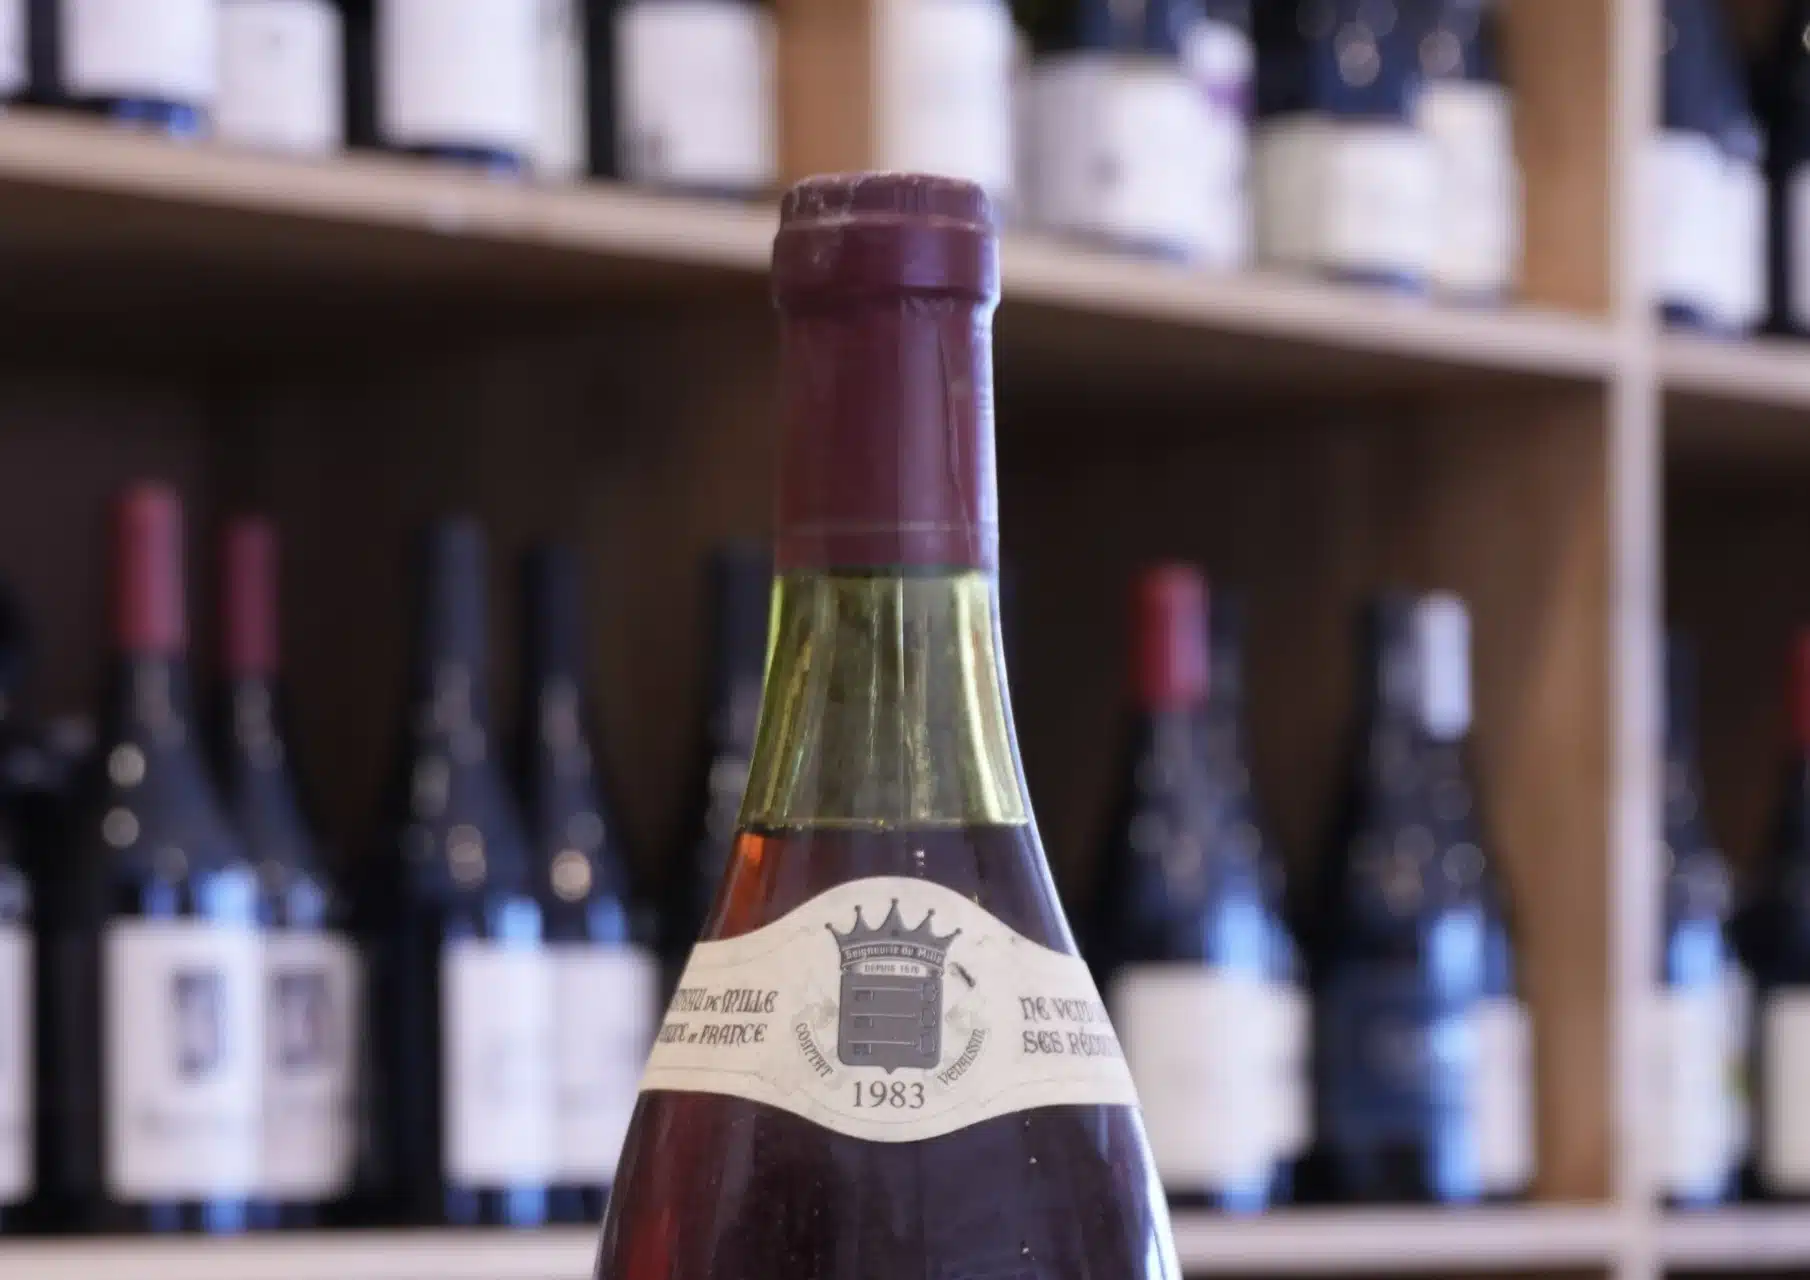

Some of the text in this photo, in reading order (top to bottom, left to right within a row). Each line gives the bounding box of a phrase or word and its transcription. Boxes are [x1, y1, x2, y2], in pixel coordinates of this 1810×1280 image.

[720, 987, 779, 1014] MILLE
[699, 1023, 768, 1047] FRANCE
[853, 1080, 926, 1109] 1983
